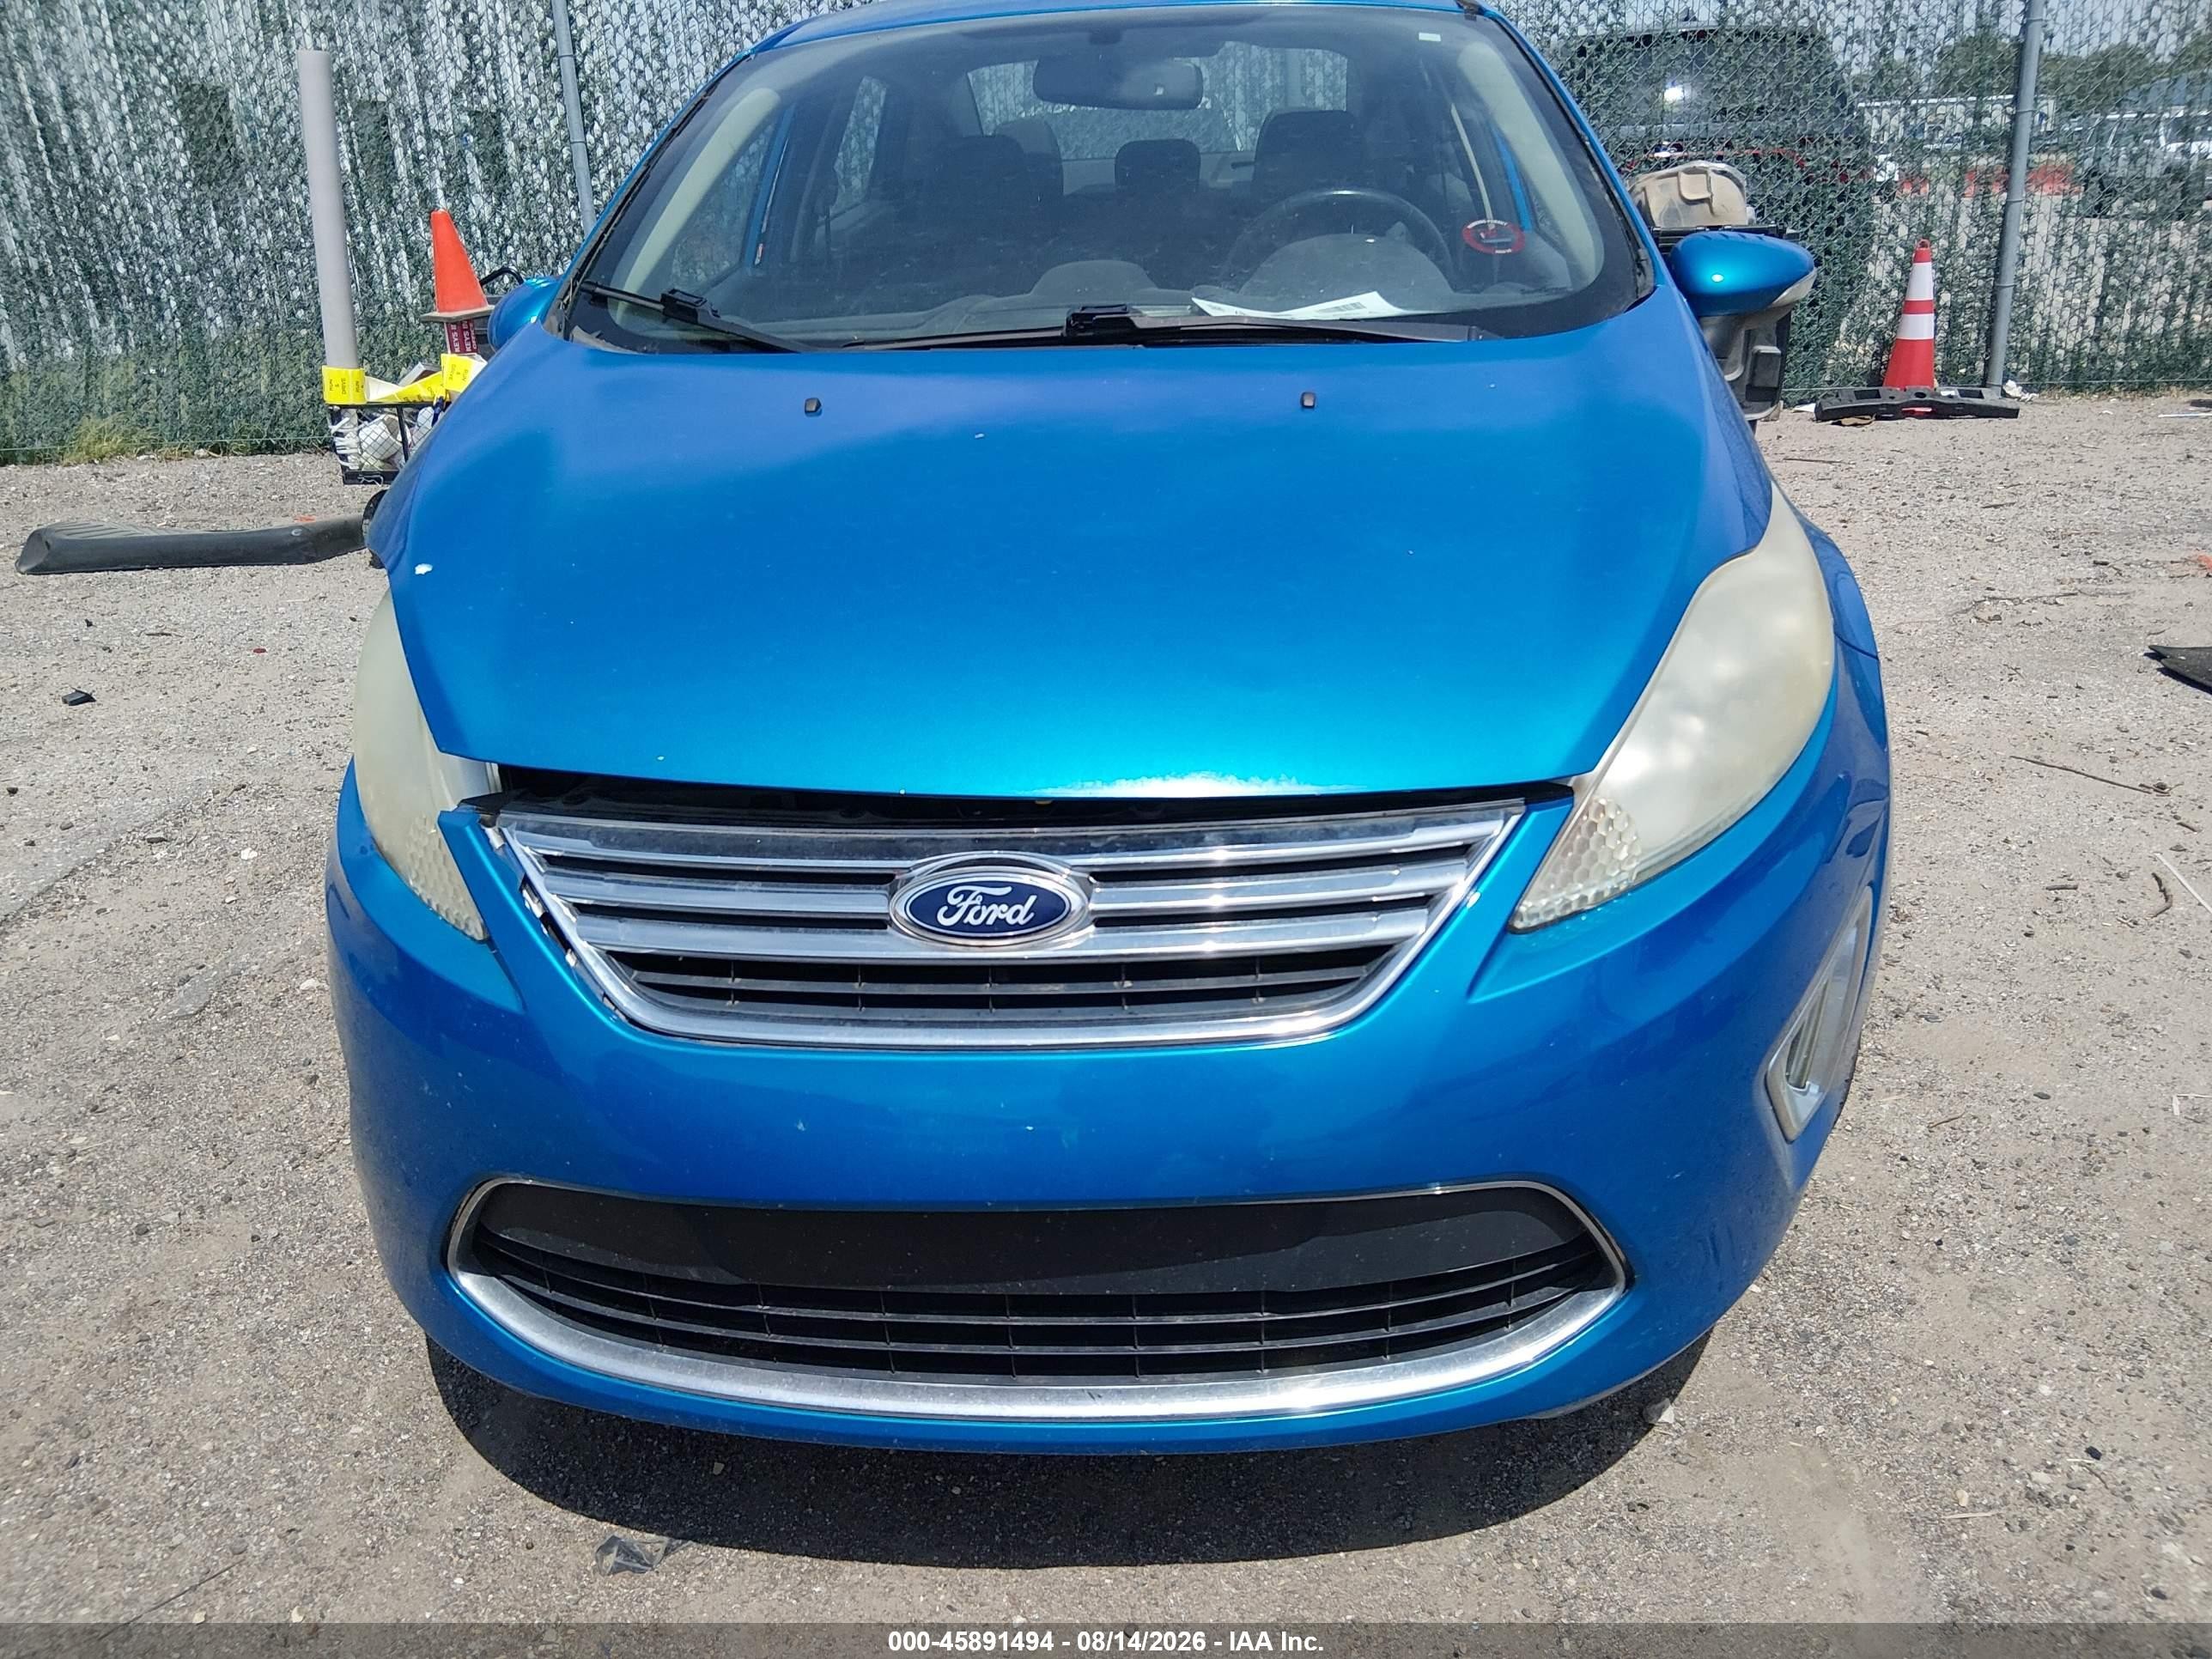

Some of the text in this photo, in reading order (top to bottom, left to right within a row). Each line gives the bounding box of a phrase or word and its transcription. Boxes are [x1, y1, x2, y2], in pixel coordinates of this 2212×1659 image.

[453, 331, 461, 353] KEYS
[463, 331, 472, 352] KEYS
[937, 885, 1037, 926] Ford
